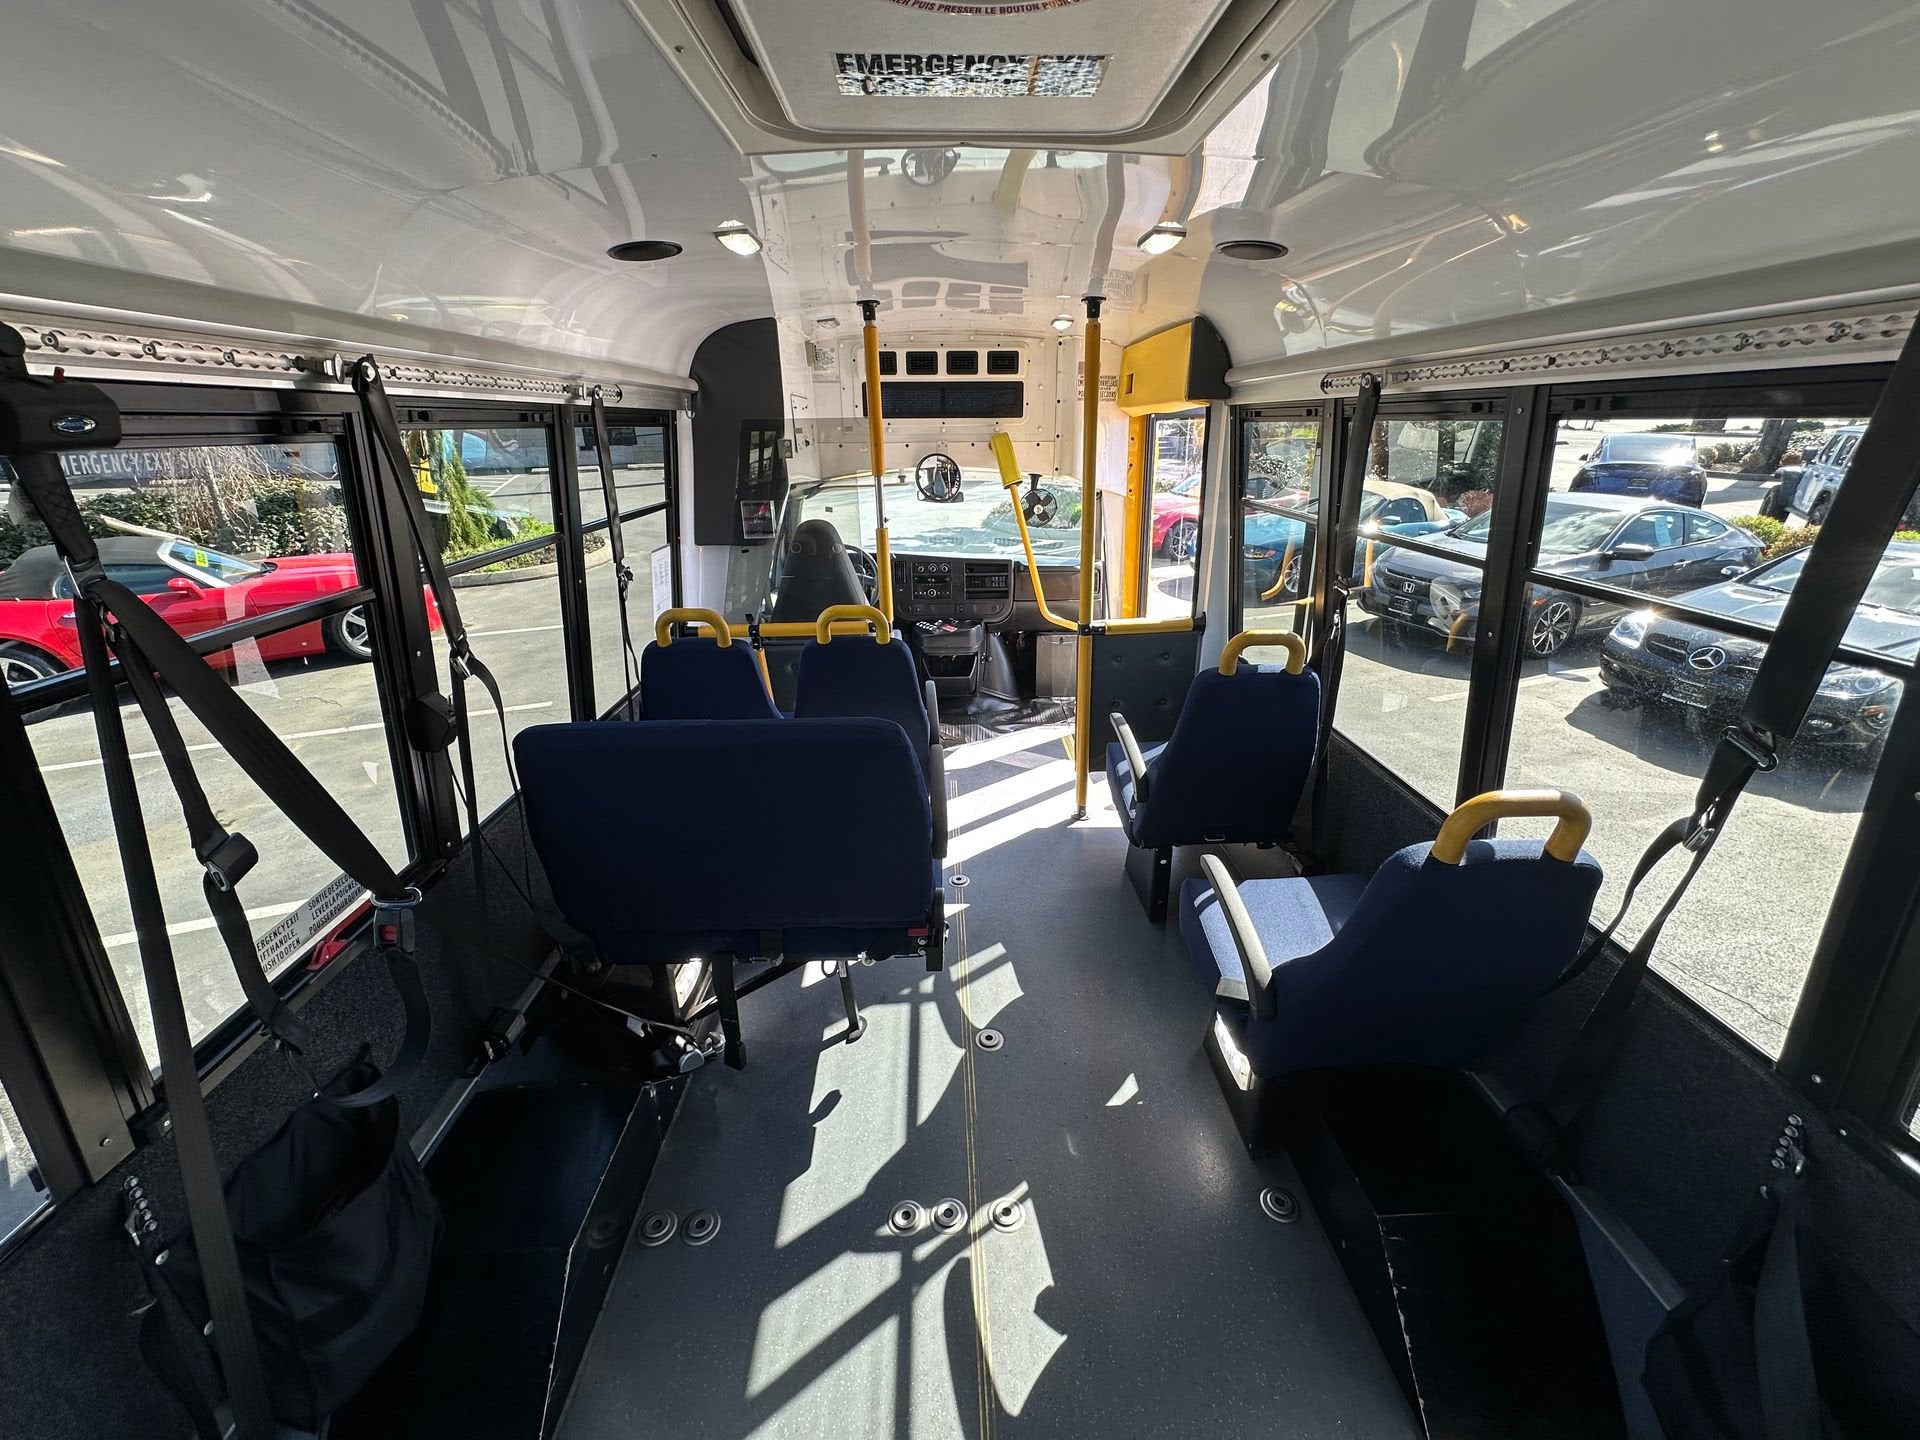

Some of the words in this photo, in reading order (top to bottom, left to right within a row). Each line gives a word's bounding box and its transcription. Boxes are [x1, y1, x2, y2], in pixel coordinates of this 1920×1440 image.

[911, 0, 936, 11] PUIS
[937, 4, 982, 14] PRESSER
[984, 6, 997, 14] LE
[999, 4, 1040, 14] BOUTON
[60, 452, 140, 476] MERGENCY
[256, 922, 286, 952] ERGENCY
[285, 912, 299, 929] EXIT
[259, 948, 270, 963] IFT
[262, 956, 277, 973] USH
[284, 936, 301, 956] OPEN
